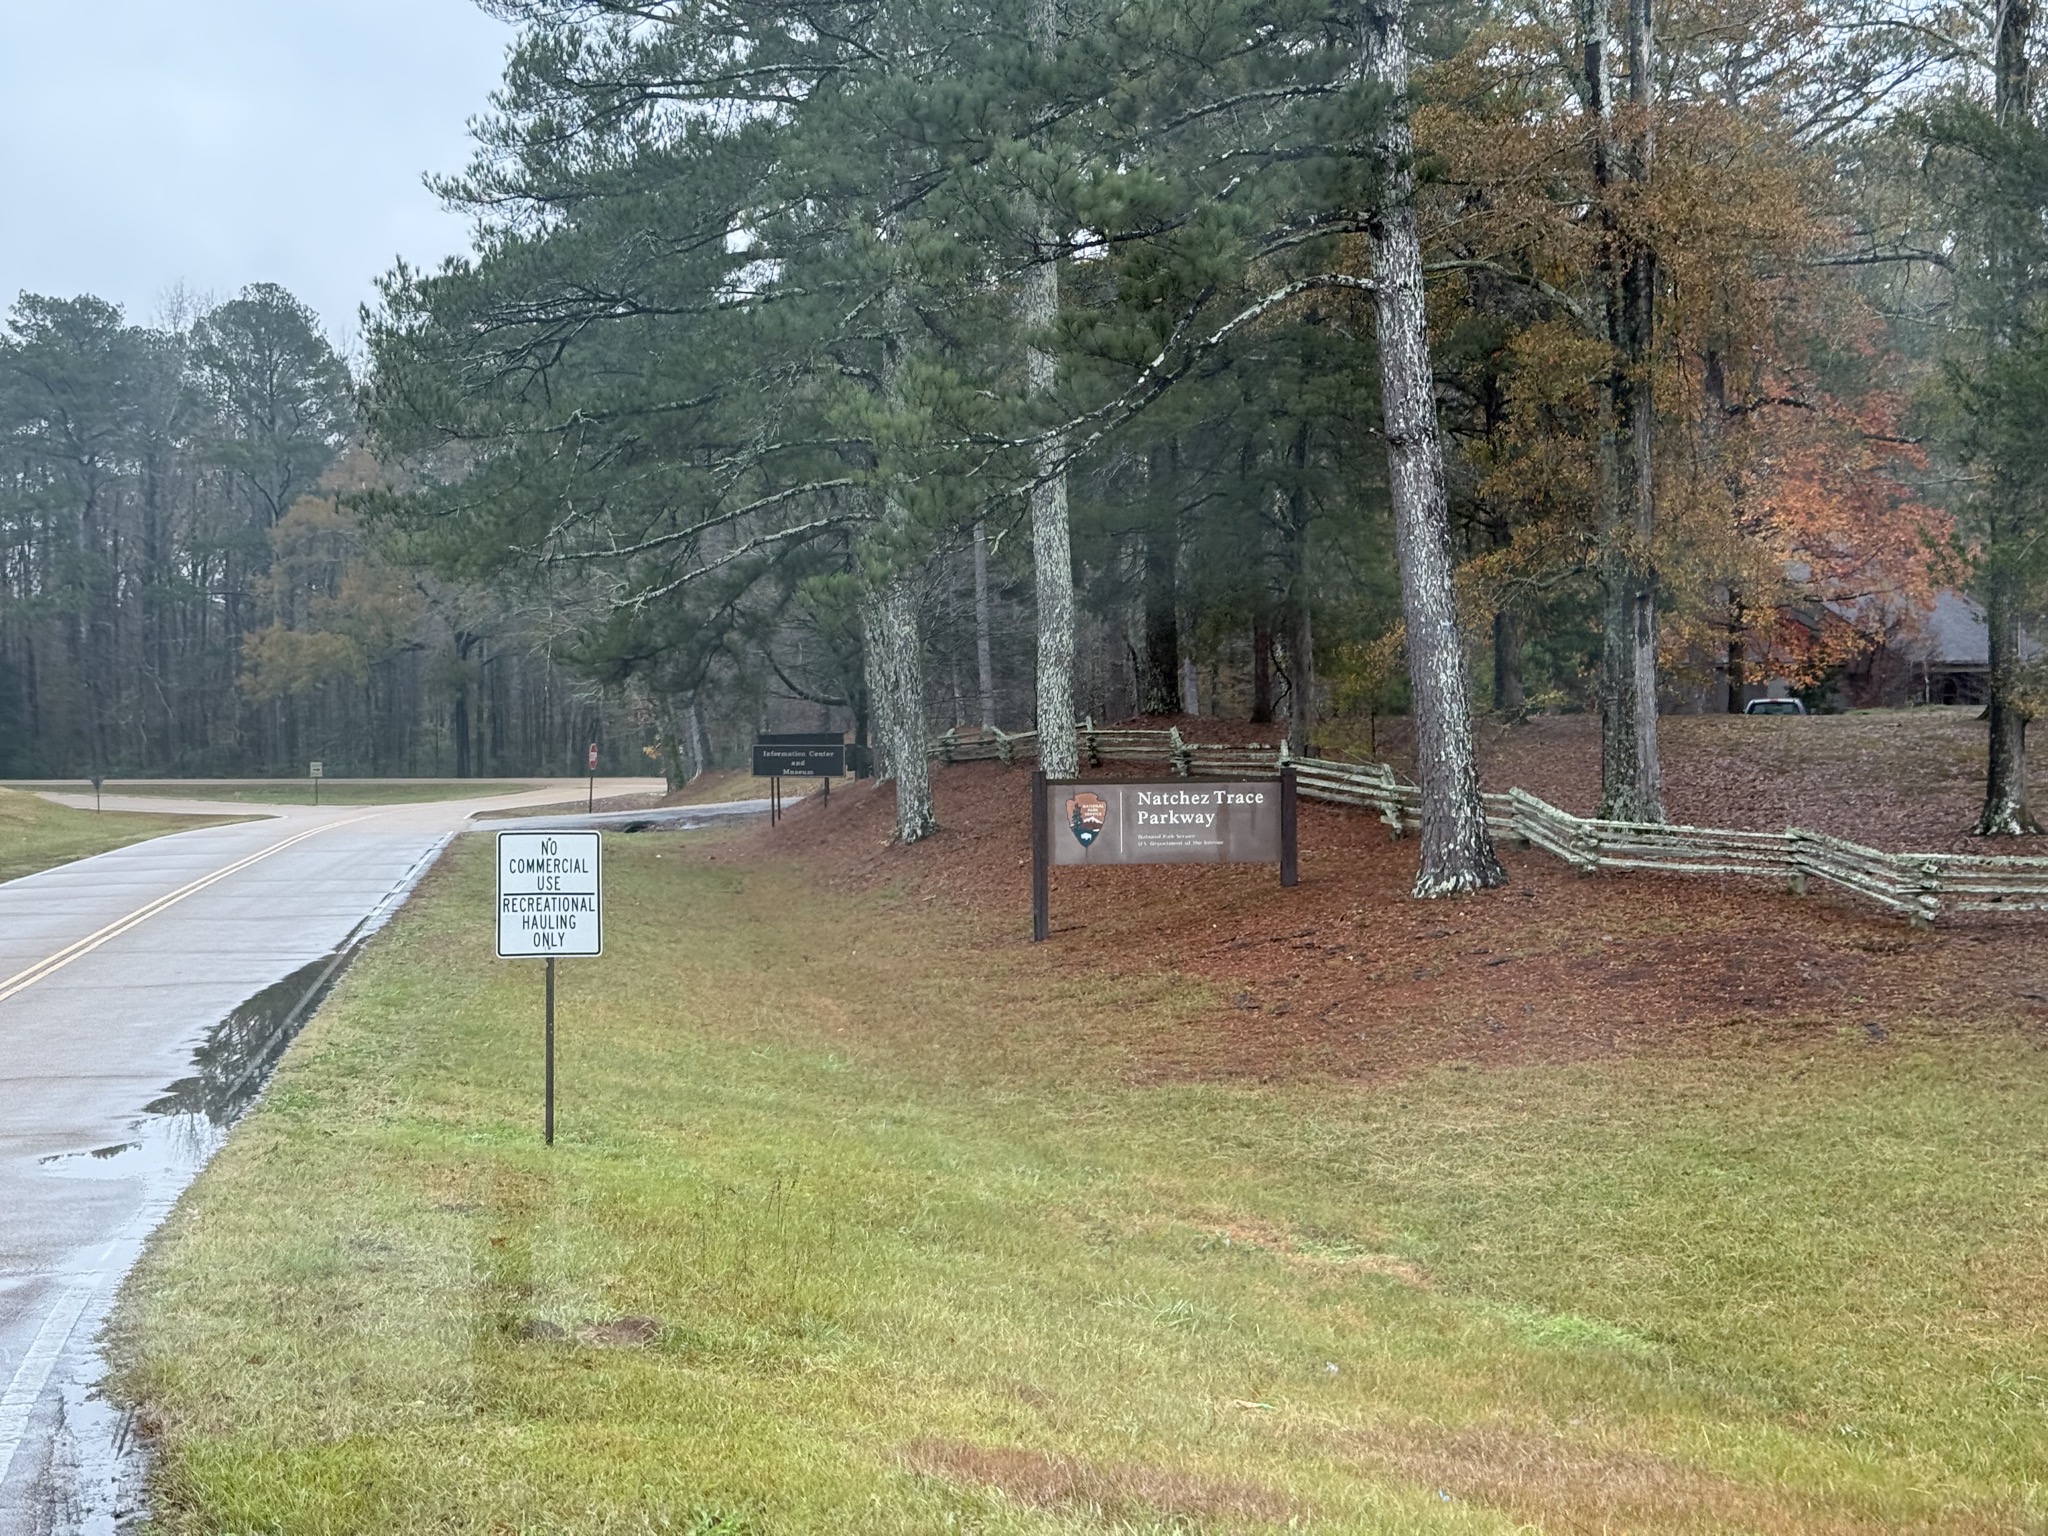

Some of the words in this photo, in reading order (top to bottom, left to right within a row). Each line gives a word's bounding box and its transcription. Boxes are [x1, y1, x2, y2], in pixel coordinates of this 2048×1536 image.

[1137, 790, 1210, 806] Natchez
[1213, 790, 1264, 804] Trace
[1137, 810, 1215, 828] Parkway
[541, 840, 557, 855] NO
[509, 858, 589, 873] COMMERCIAL
[537, 876, 561, 891] USE
[503, 897, 595, 913] RECREATIONAL
[522, 914, 576, 930] HAULING
[533, 932, 565, 947] ONLY
